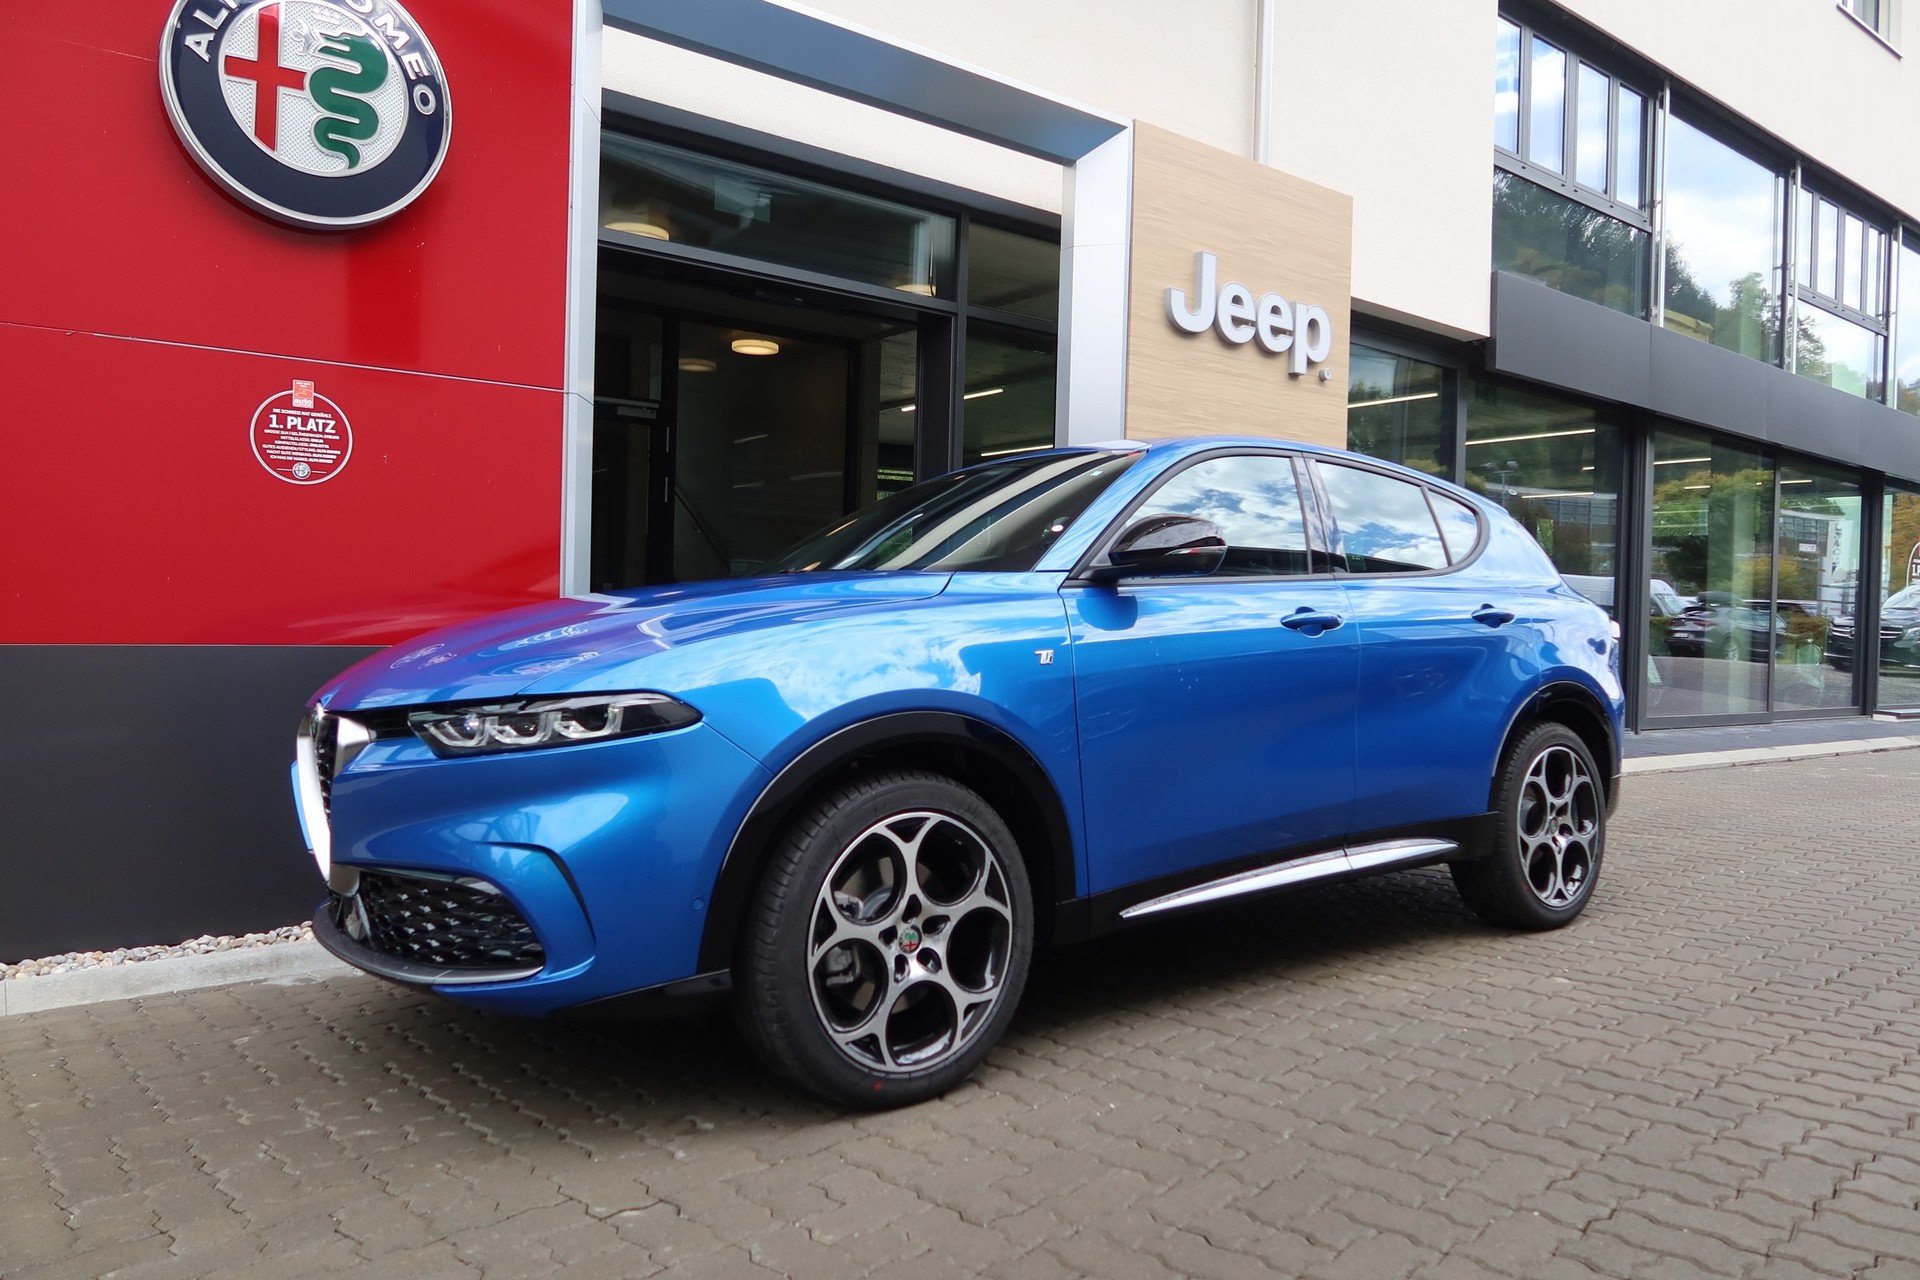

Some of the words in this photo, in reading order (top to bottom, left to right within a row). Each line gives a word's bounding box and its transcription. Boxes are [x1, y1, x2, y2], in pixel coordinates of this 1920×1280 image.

[184, 0, 239, 63] AL
[1164, 251, 1331, 376] Jeep
[269, 414, 284, 429] 1.
[287, 416, 336, 433] PLATZ
